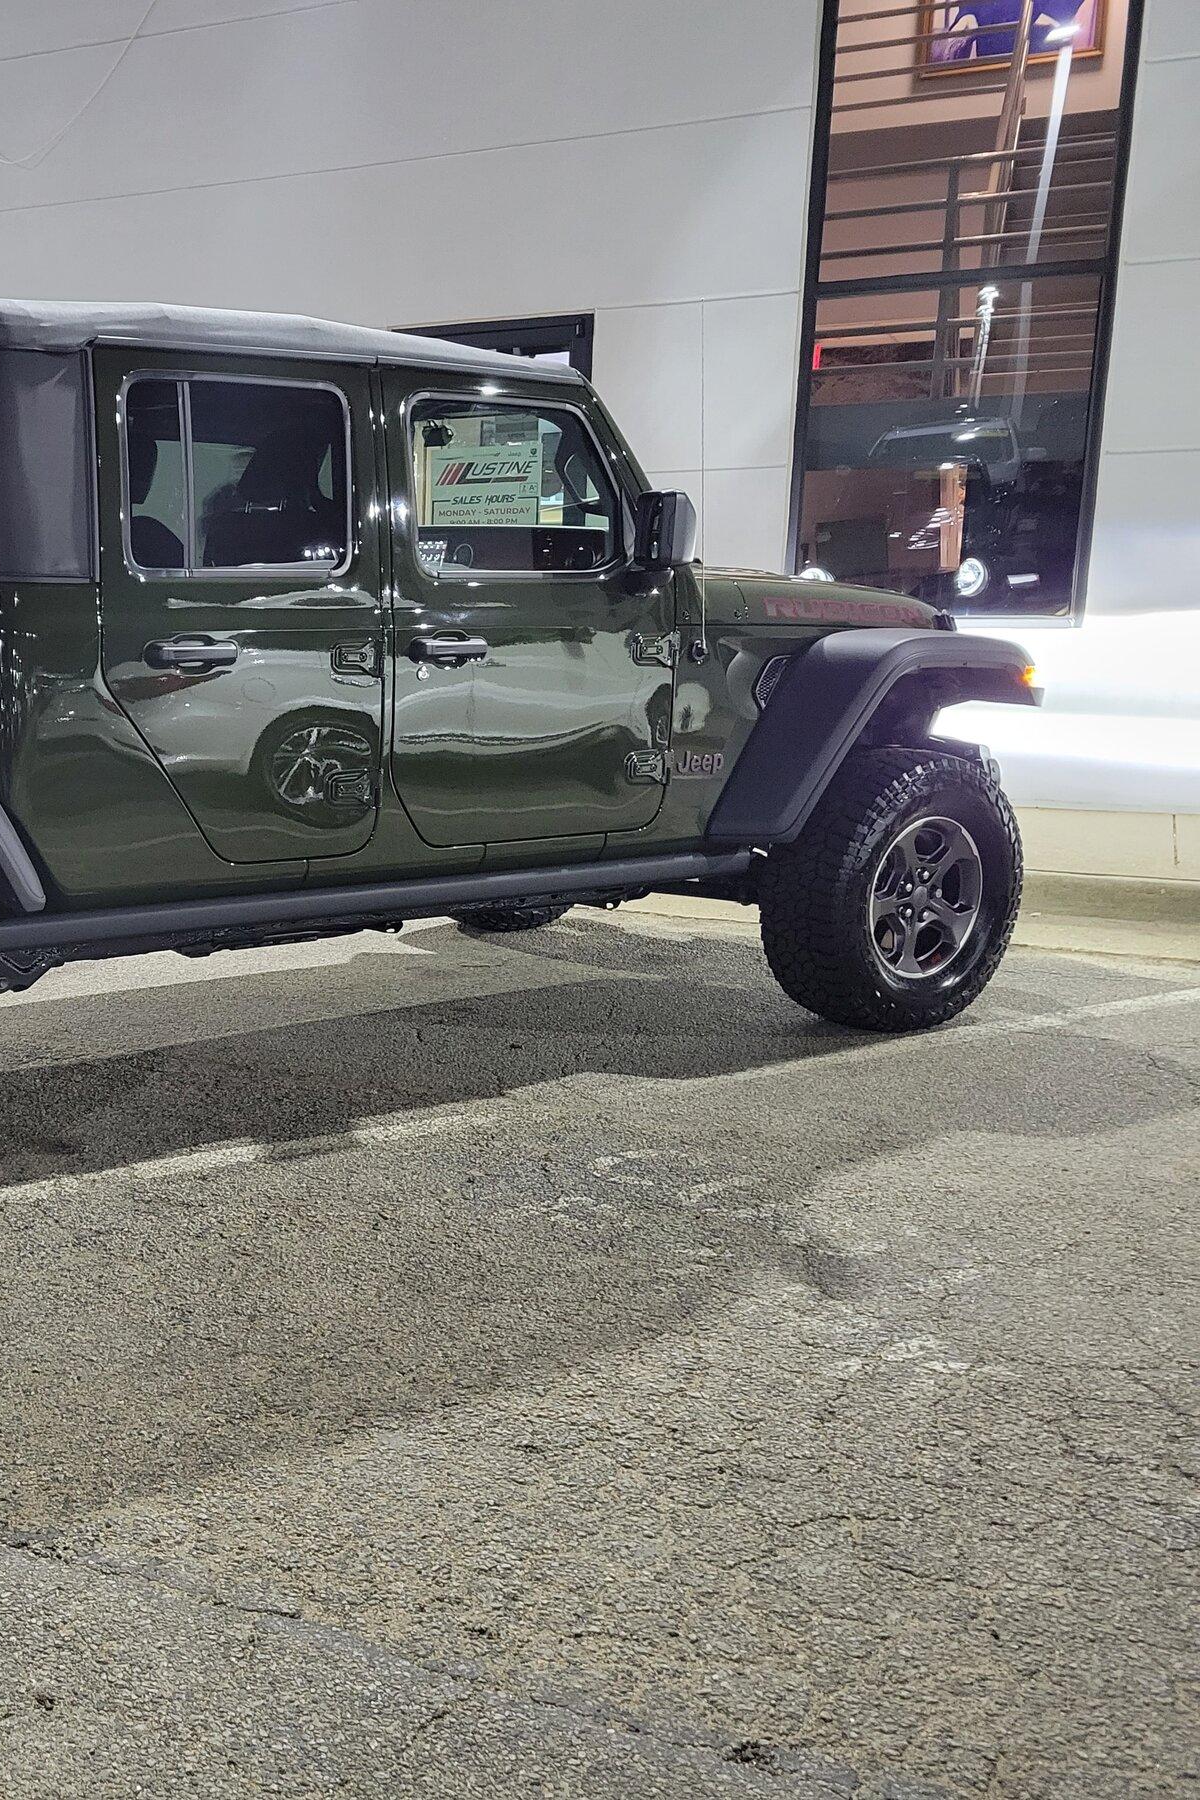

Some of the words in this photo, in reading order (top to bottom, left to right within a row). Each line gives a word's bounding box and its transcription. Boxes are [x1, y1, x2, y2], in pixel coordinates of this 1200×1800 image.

[453, 460, 538, 486] LUSTINE
[451, 495, 483, 505] SALES
[484, 494, 517, 505] HOURS
[438, 508, 477, 517] MONDAY
[483, 506, 531, 516] SATURDAY
[505, 517, 518, 525] PM
[764, 597, 925, 622] RUBICON
[676, 751, 724, 774] Jeep
